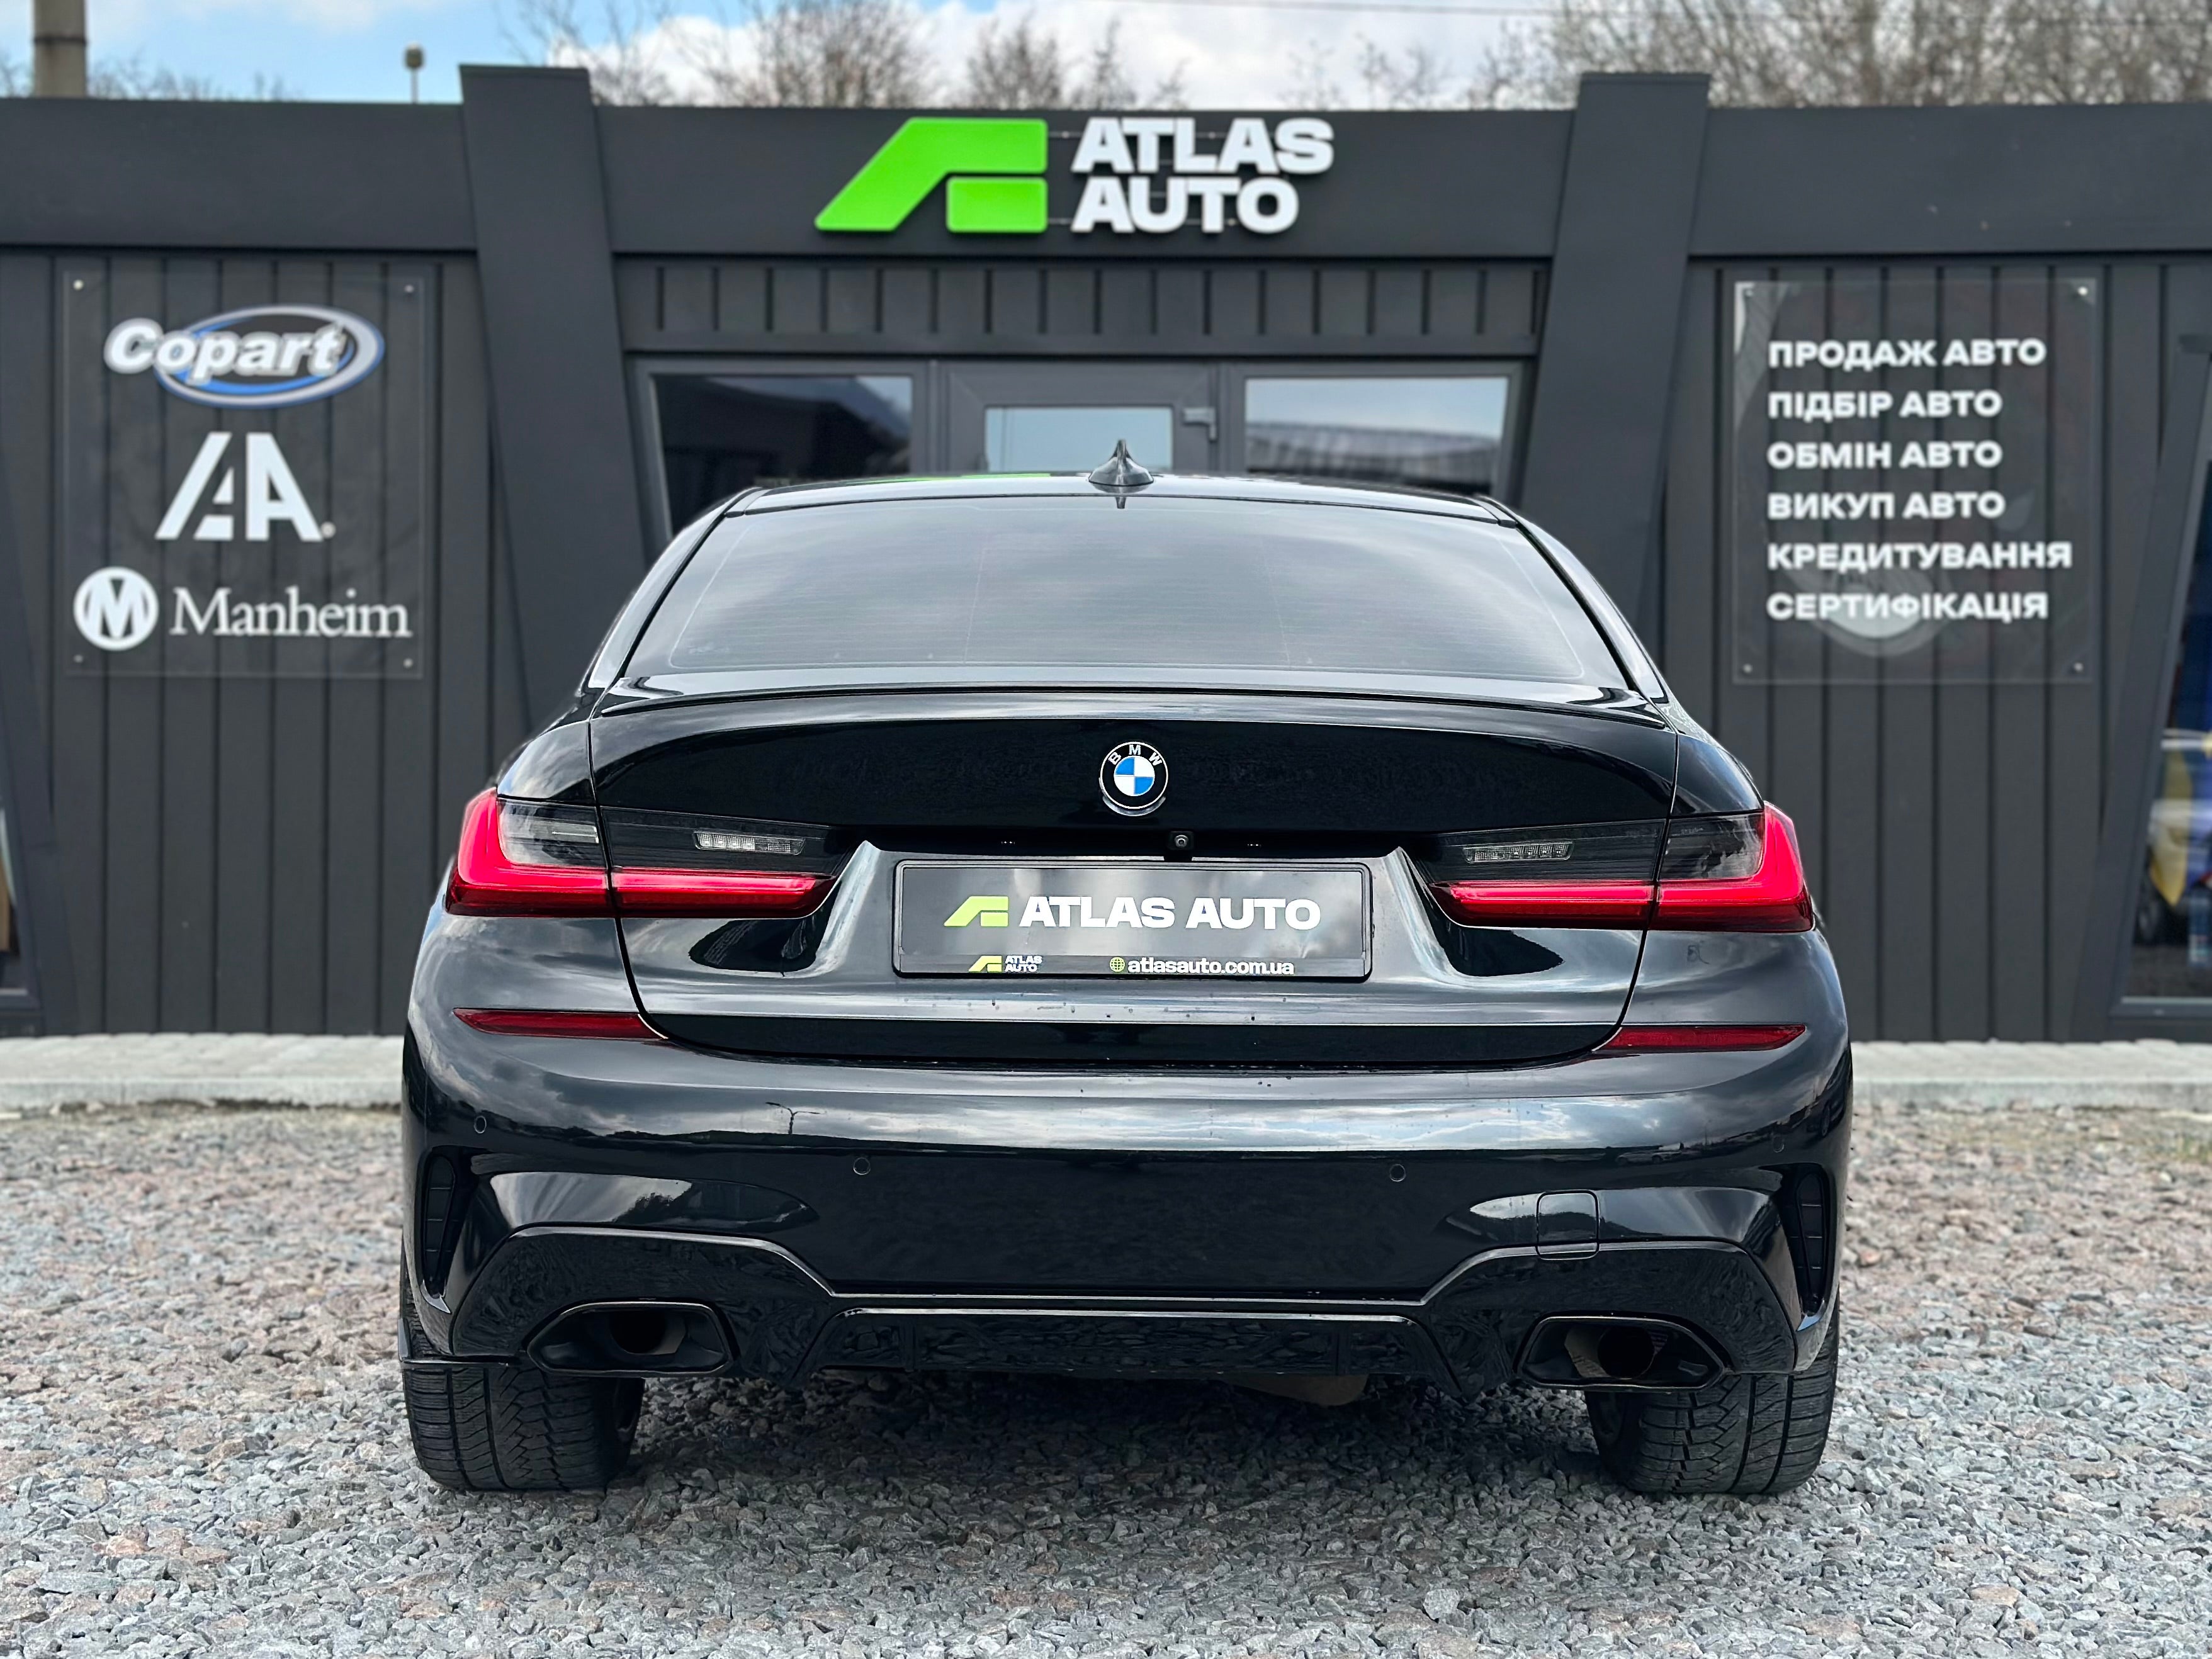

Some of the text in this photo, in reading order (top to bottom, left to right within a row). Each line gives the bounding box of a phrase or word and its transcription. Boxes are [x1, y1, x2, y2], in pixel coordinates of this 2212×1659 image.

[1073, 117, 1333, 173] ATLAS
[1073, 177, 1299, 232] AUTO
[106, 320, 344, 382] Copart
[1769, 339, 2046, 371] ПРОДАЖ АВТО
[1769, 390, 2002, 422] ПІДБІР АВТО
[1767, 441, 2002, 469] ОБМІН АВТО
[1768, 492, 2006, 519] ВИКУП АВТО
[1768, 543, 2072, 573] КРЕДИТУВАННЯ
[171, 586, 411, 637] Manheim
[1767, 592, 2048, 622] СЕРТИФІКАЦІЯ
[1108, 744, 1163, 766] BMW
[1019, 896, 1321, 930] ATLAS AUTO
[1005, 955, 1042, 964] ATLAS
[1005, 964, 1037, 972] AUTO
[1127, 957, 1294, 975] atlasauto.com.ua
